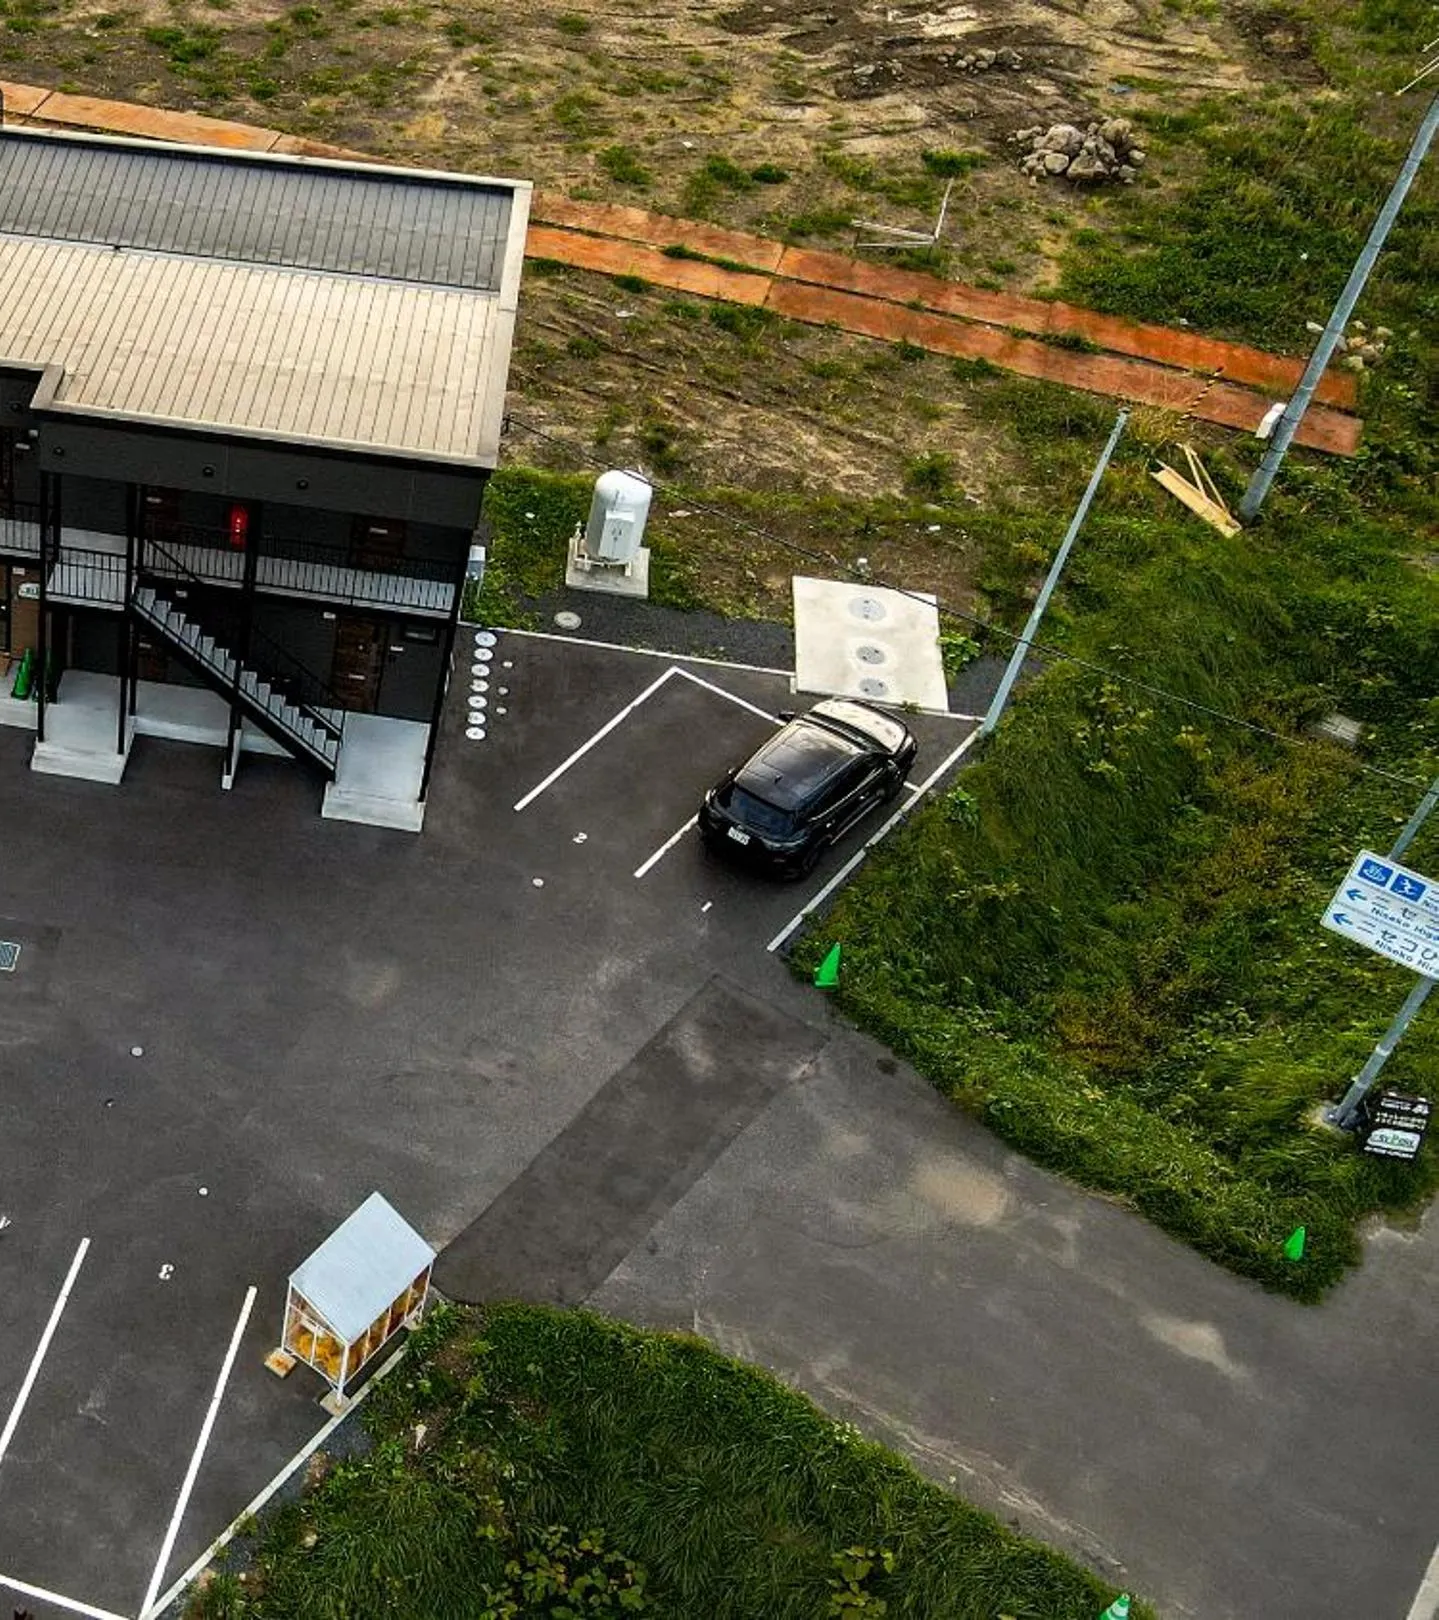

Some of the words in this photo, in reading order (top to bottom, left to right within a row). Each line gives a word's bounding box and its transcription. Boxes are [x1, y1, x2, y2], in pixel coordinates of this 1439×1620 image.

[1371, 906, 1411, 928] Niseko
[1375, 939, 1413, 962] Niseko
[158, 1263, 175, 1281] 3
